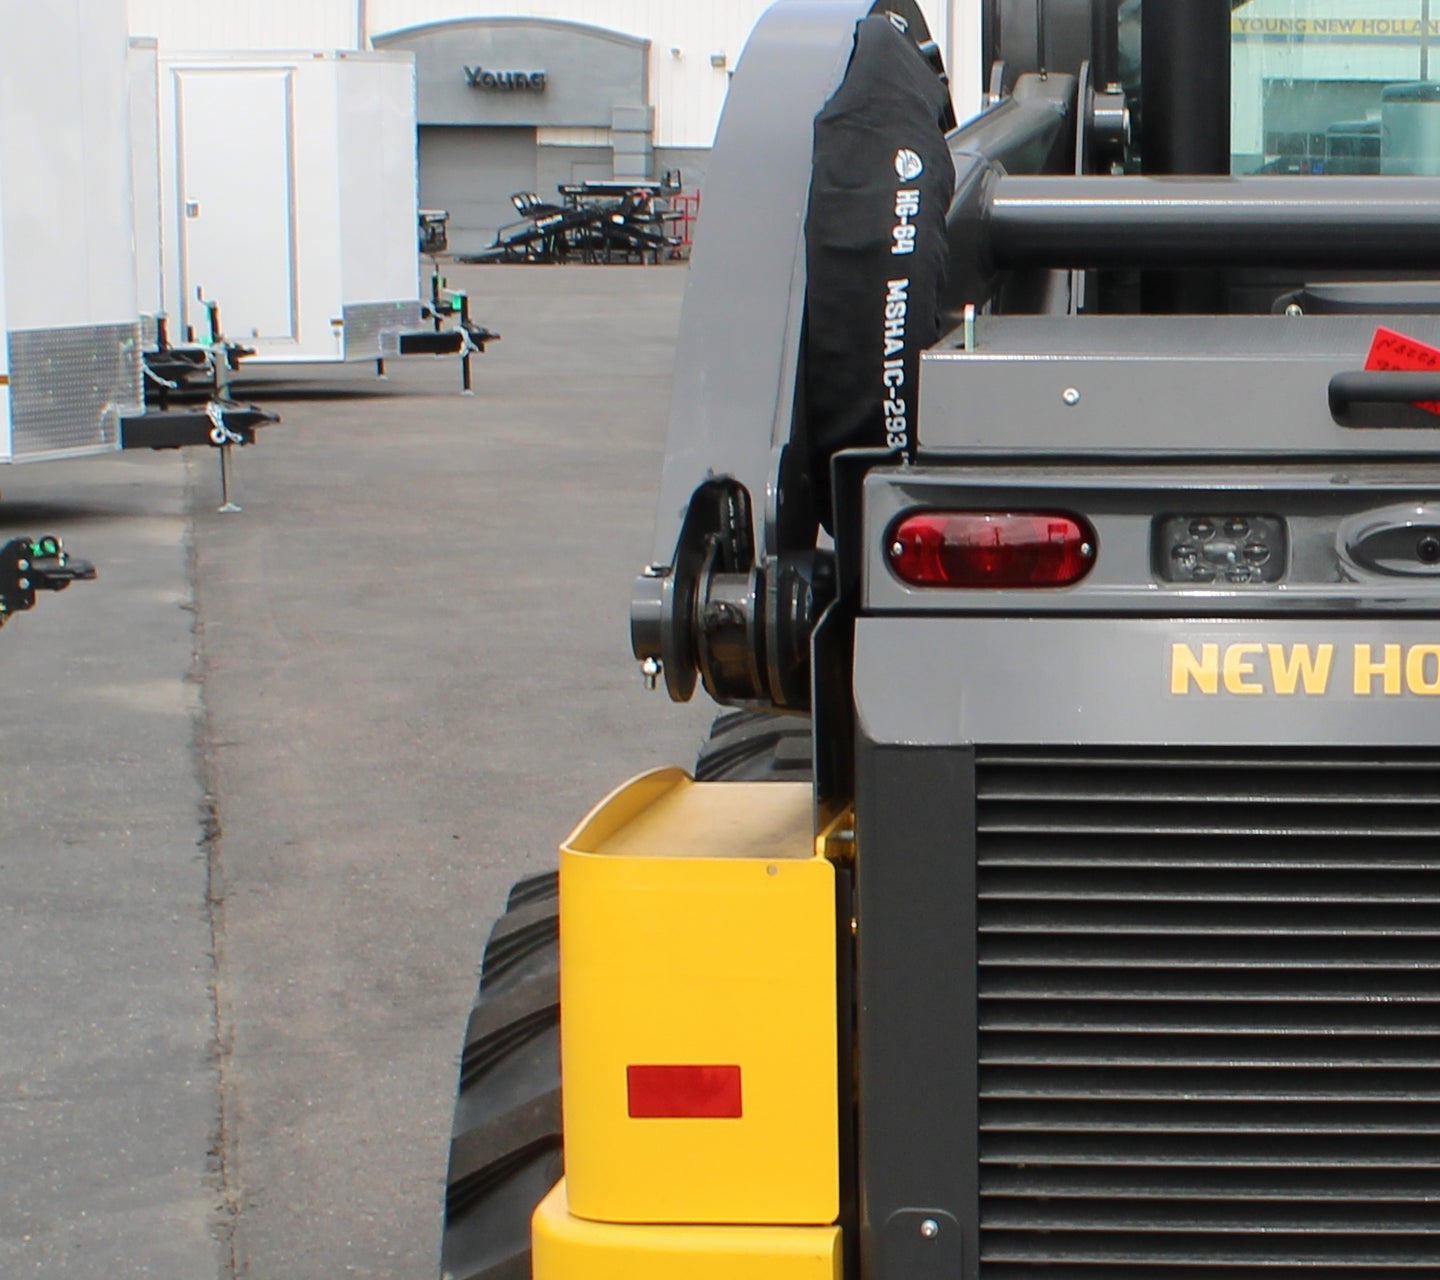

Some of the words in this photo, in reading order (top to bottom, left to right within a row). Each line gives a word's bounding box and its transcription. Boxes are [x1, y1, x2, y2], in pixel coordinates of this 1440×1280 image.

[1238, 18, 1307, 33] YOUNG
[1313, 18, 1355, 33] NEW
[463, 64, 545, 91] Young
[884, 277, 909, 356] MSHA
[883, 359, 910, 468] IC-293
[1170, 642, 1334, 695] NEW
